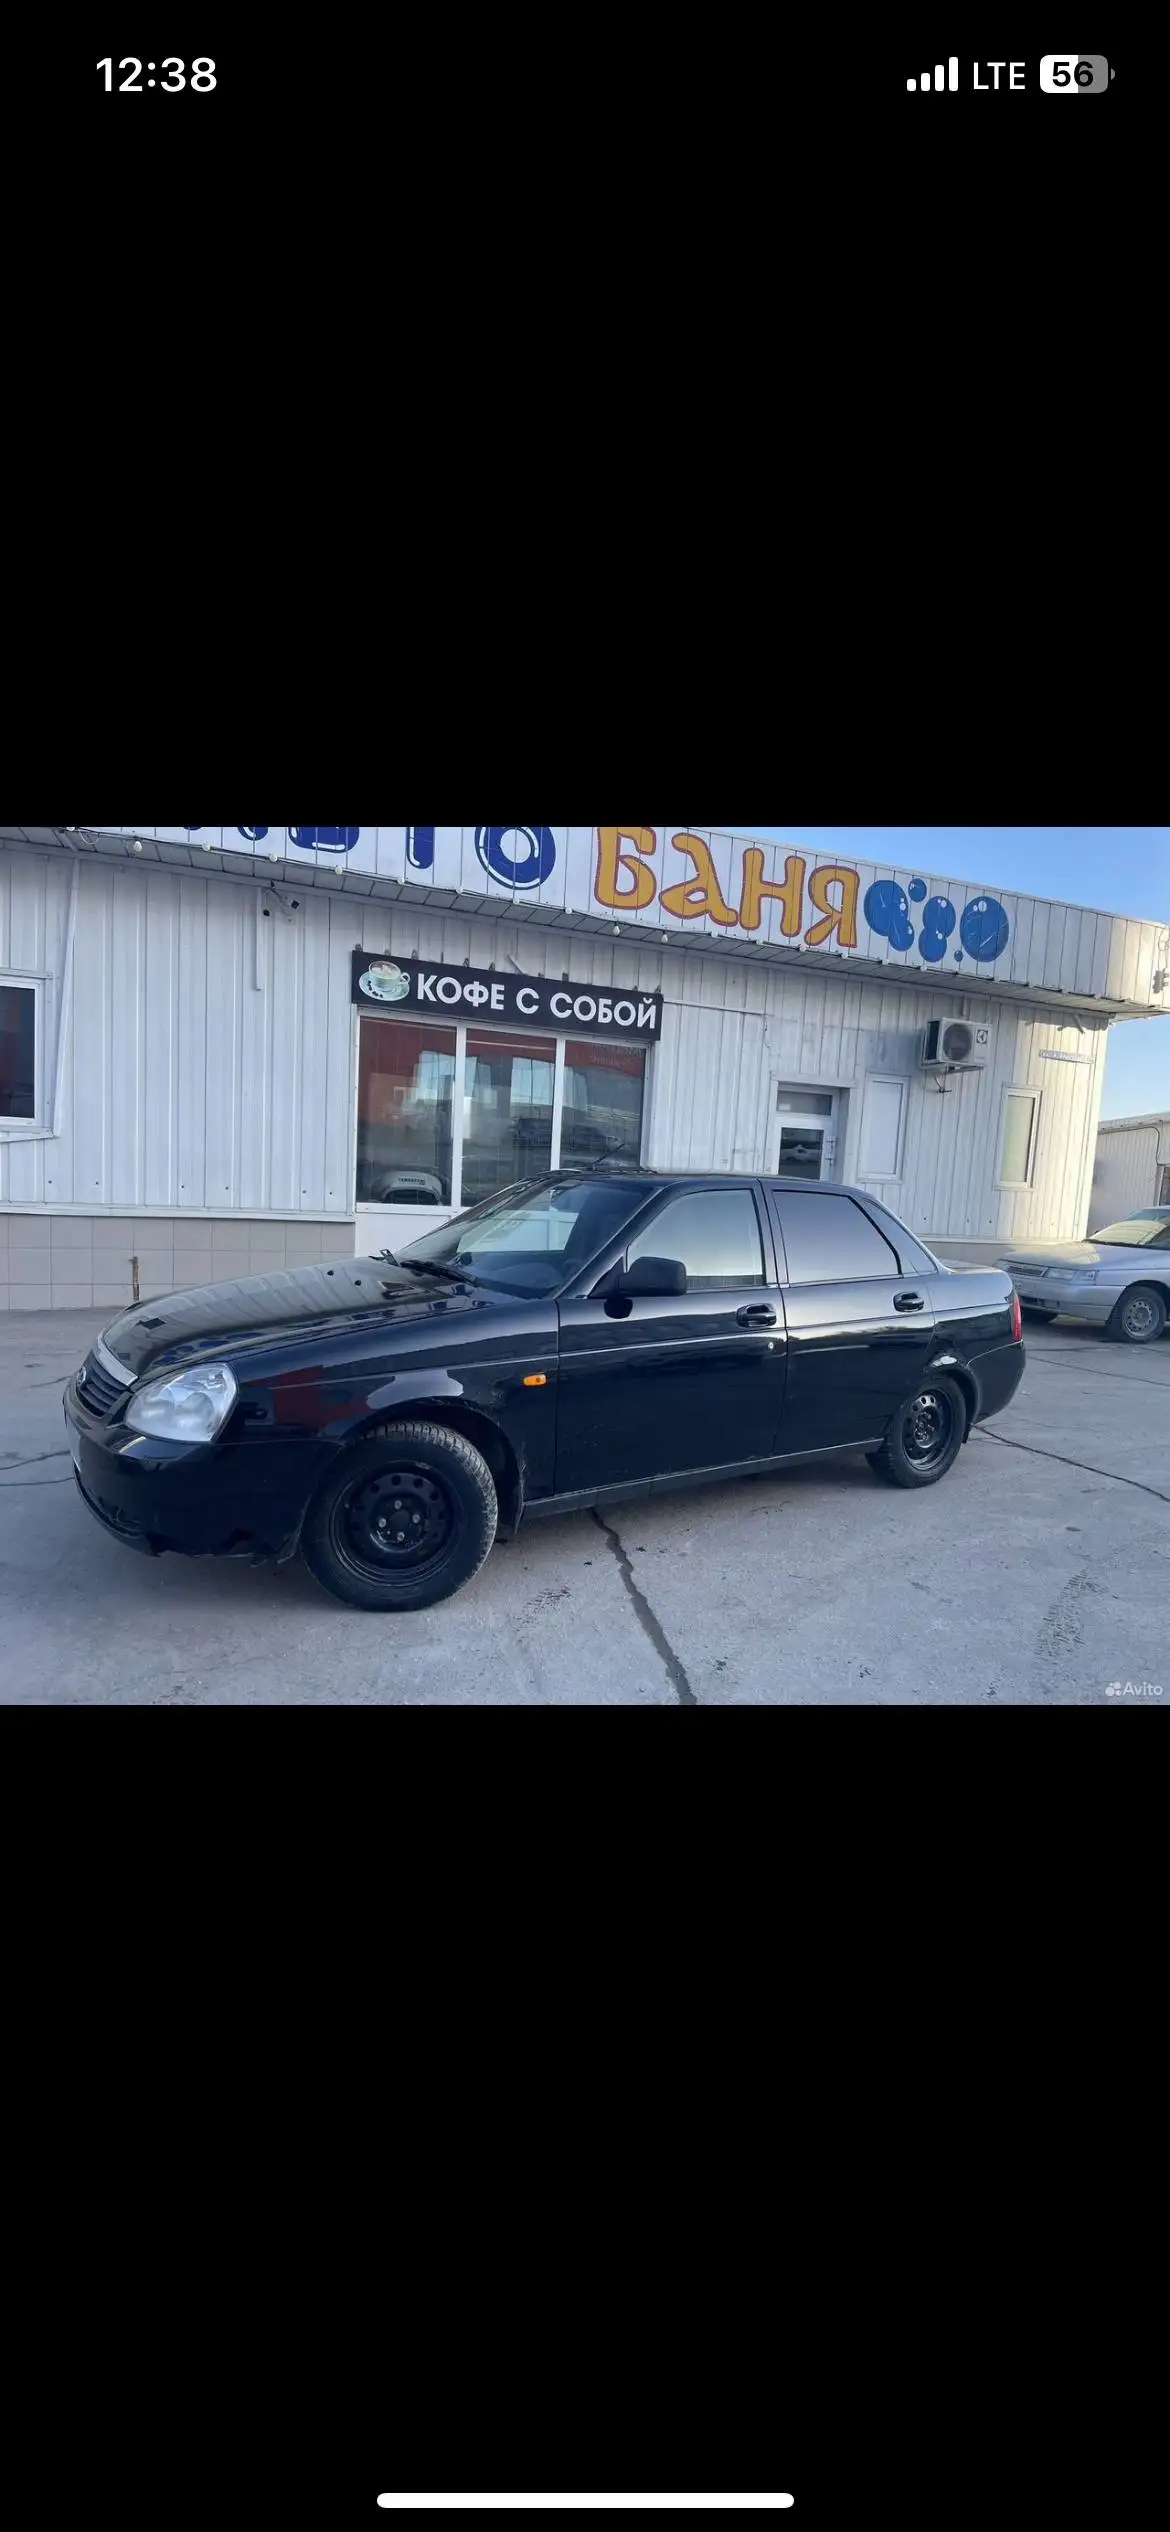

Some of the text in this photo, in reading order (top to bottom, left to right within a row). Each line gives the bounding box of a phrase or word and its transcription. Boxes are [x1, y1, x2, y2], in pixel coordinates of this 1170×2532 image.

[416, 972, 657, 1029] КОФЕ С СОБОЙ
